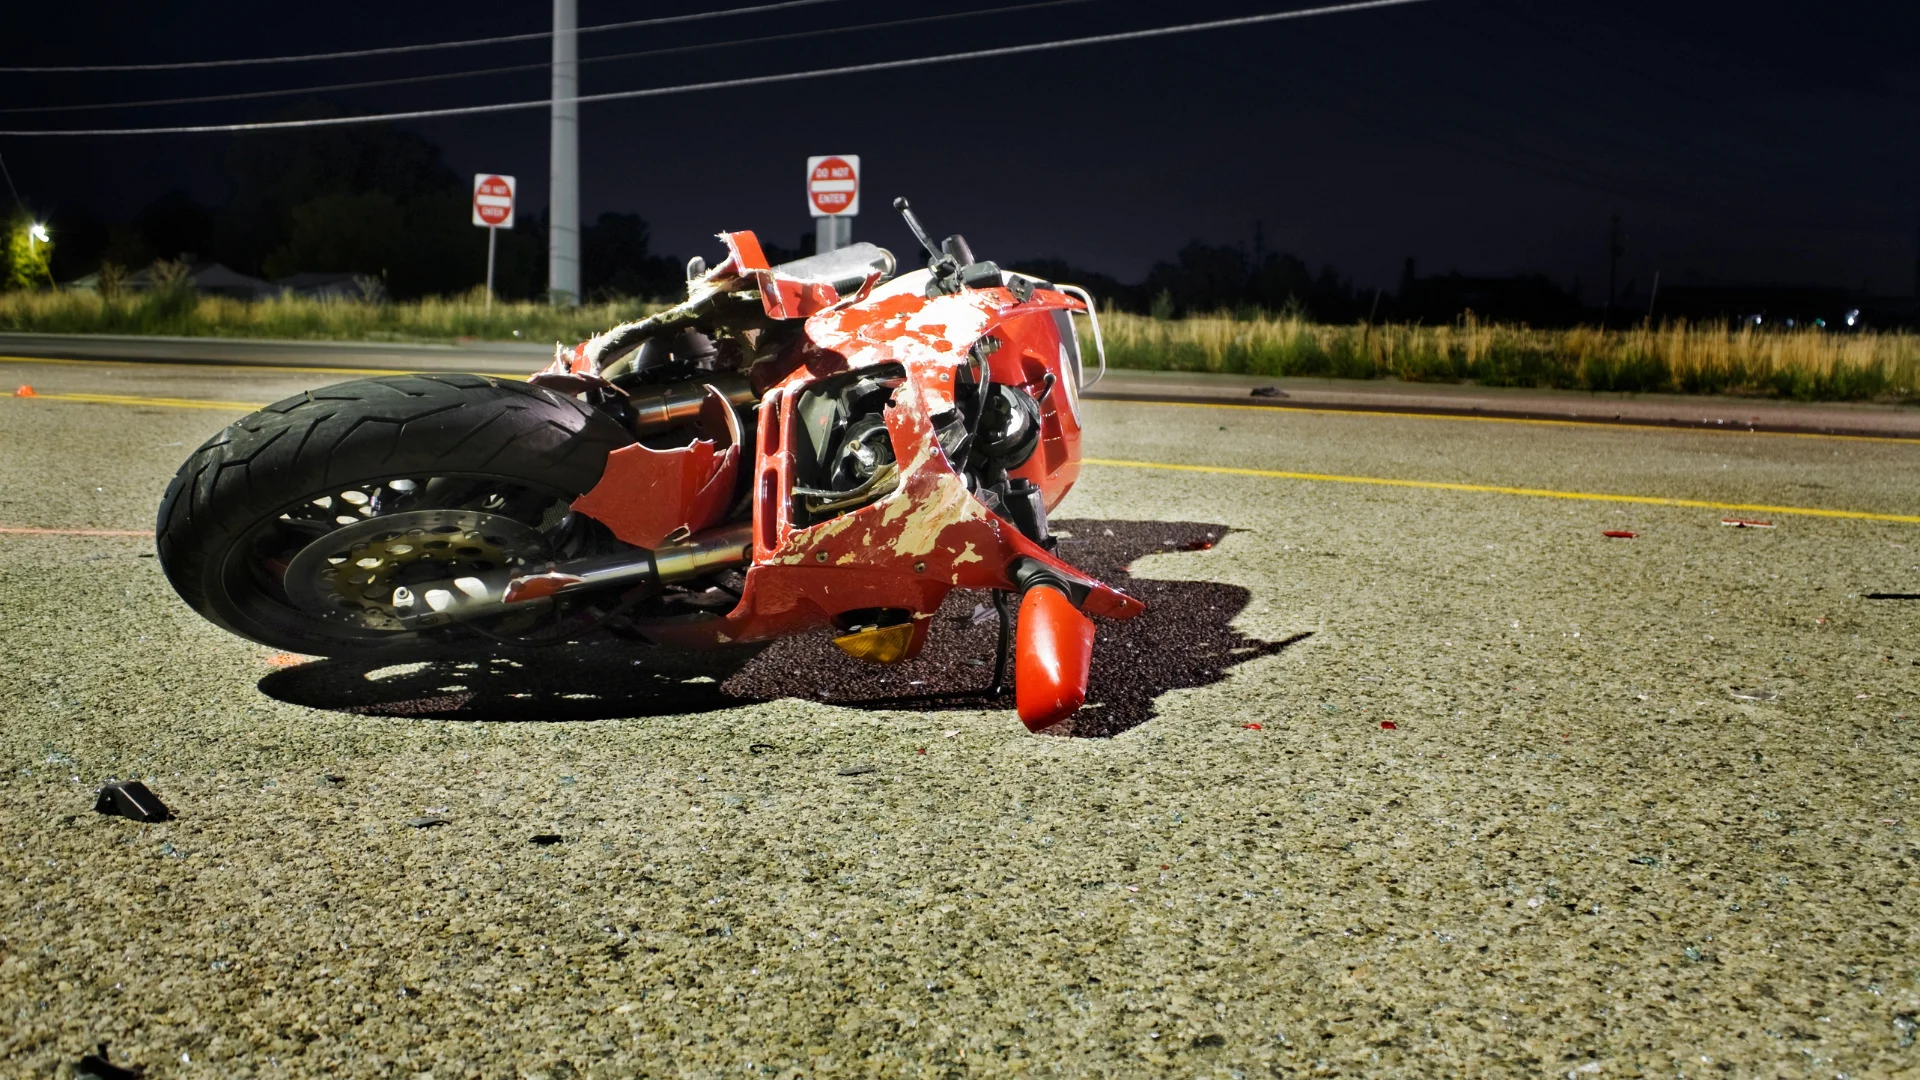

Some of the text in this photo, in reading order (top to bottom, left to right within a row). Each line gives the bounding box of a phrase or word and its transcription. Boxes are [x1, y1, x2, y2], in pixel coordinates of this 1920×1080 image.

[816, 166, 849, 178] DO NOT
[818, 193, 847, 204] ENTER
